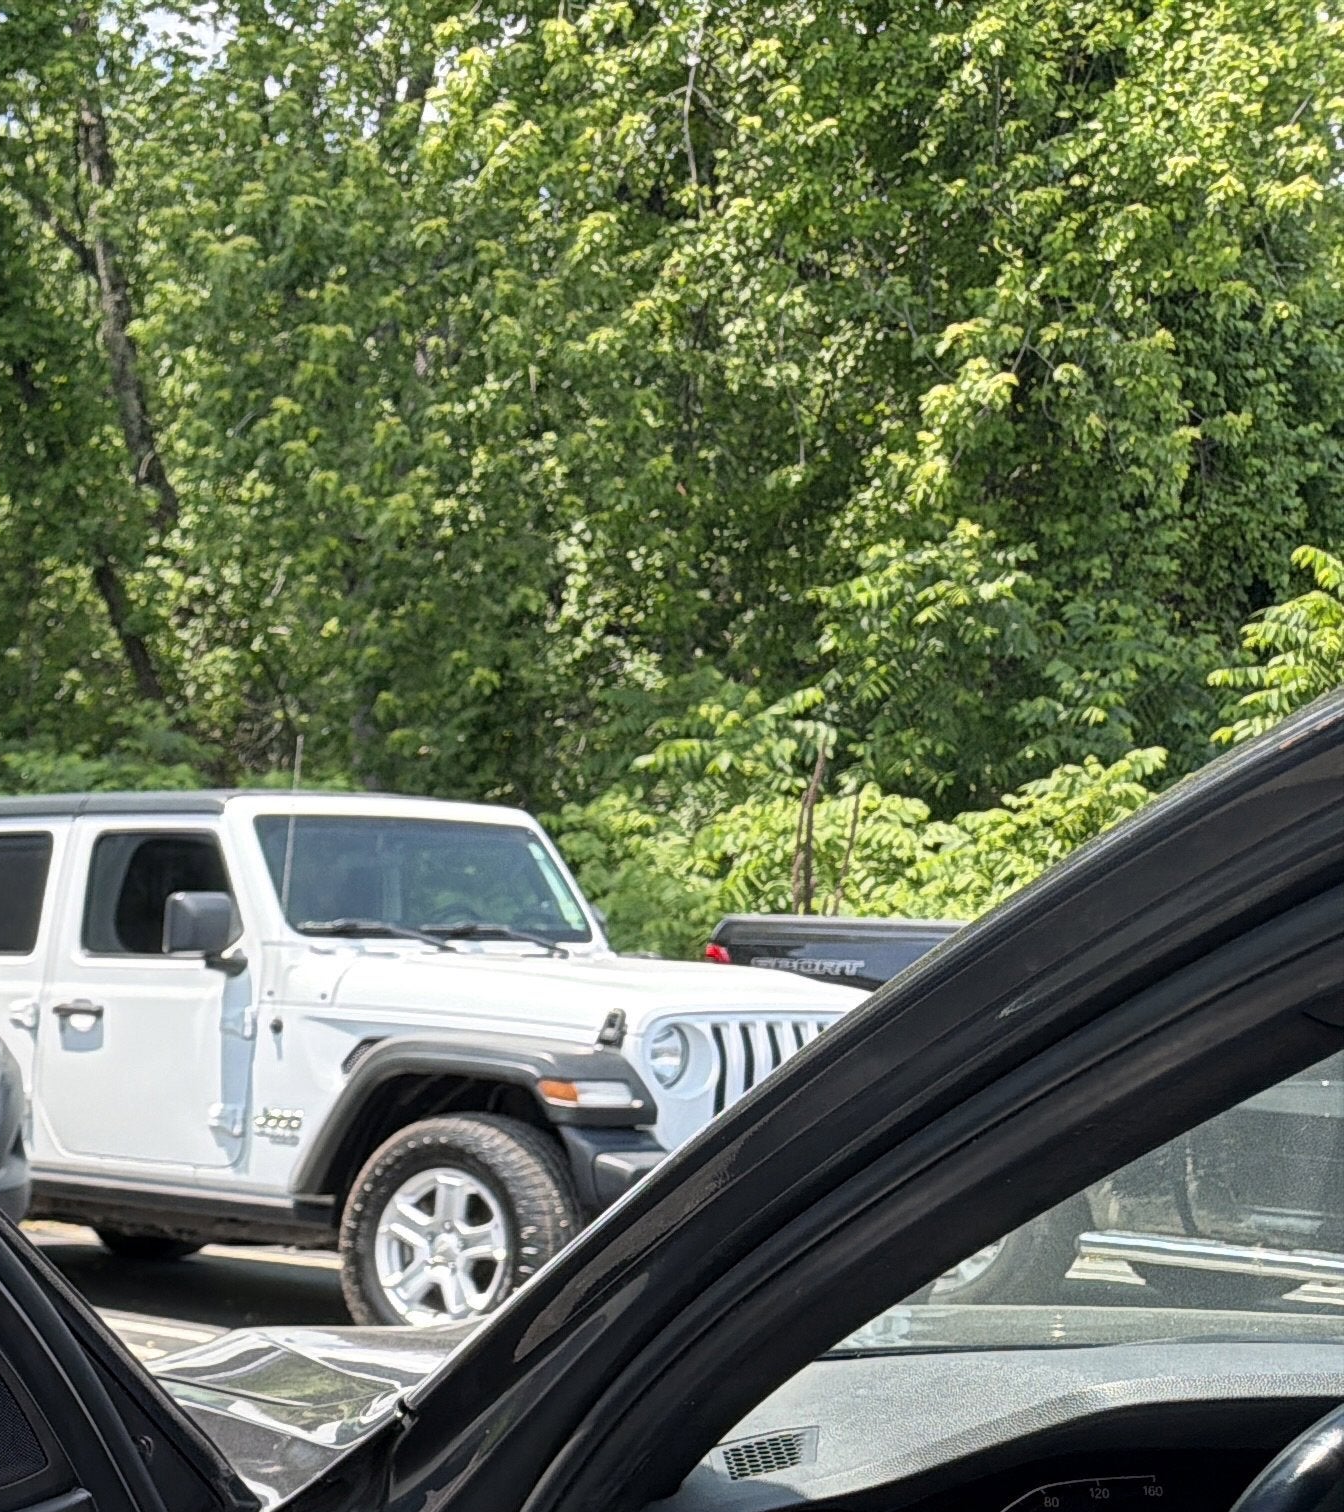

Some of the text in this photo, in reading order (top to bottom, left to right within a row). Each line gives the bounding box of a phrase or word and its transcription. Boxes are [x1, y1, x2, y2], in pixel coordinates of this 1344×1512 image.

[1089, 1487, 1110, 1499] 120
[1143, 1486, 1162, 1497] 160
[1044, 1496, 1060, 1508] 80
